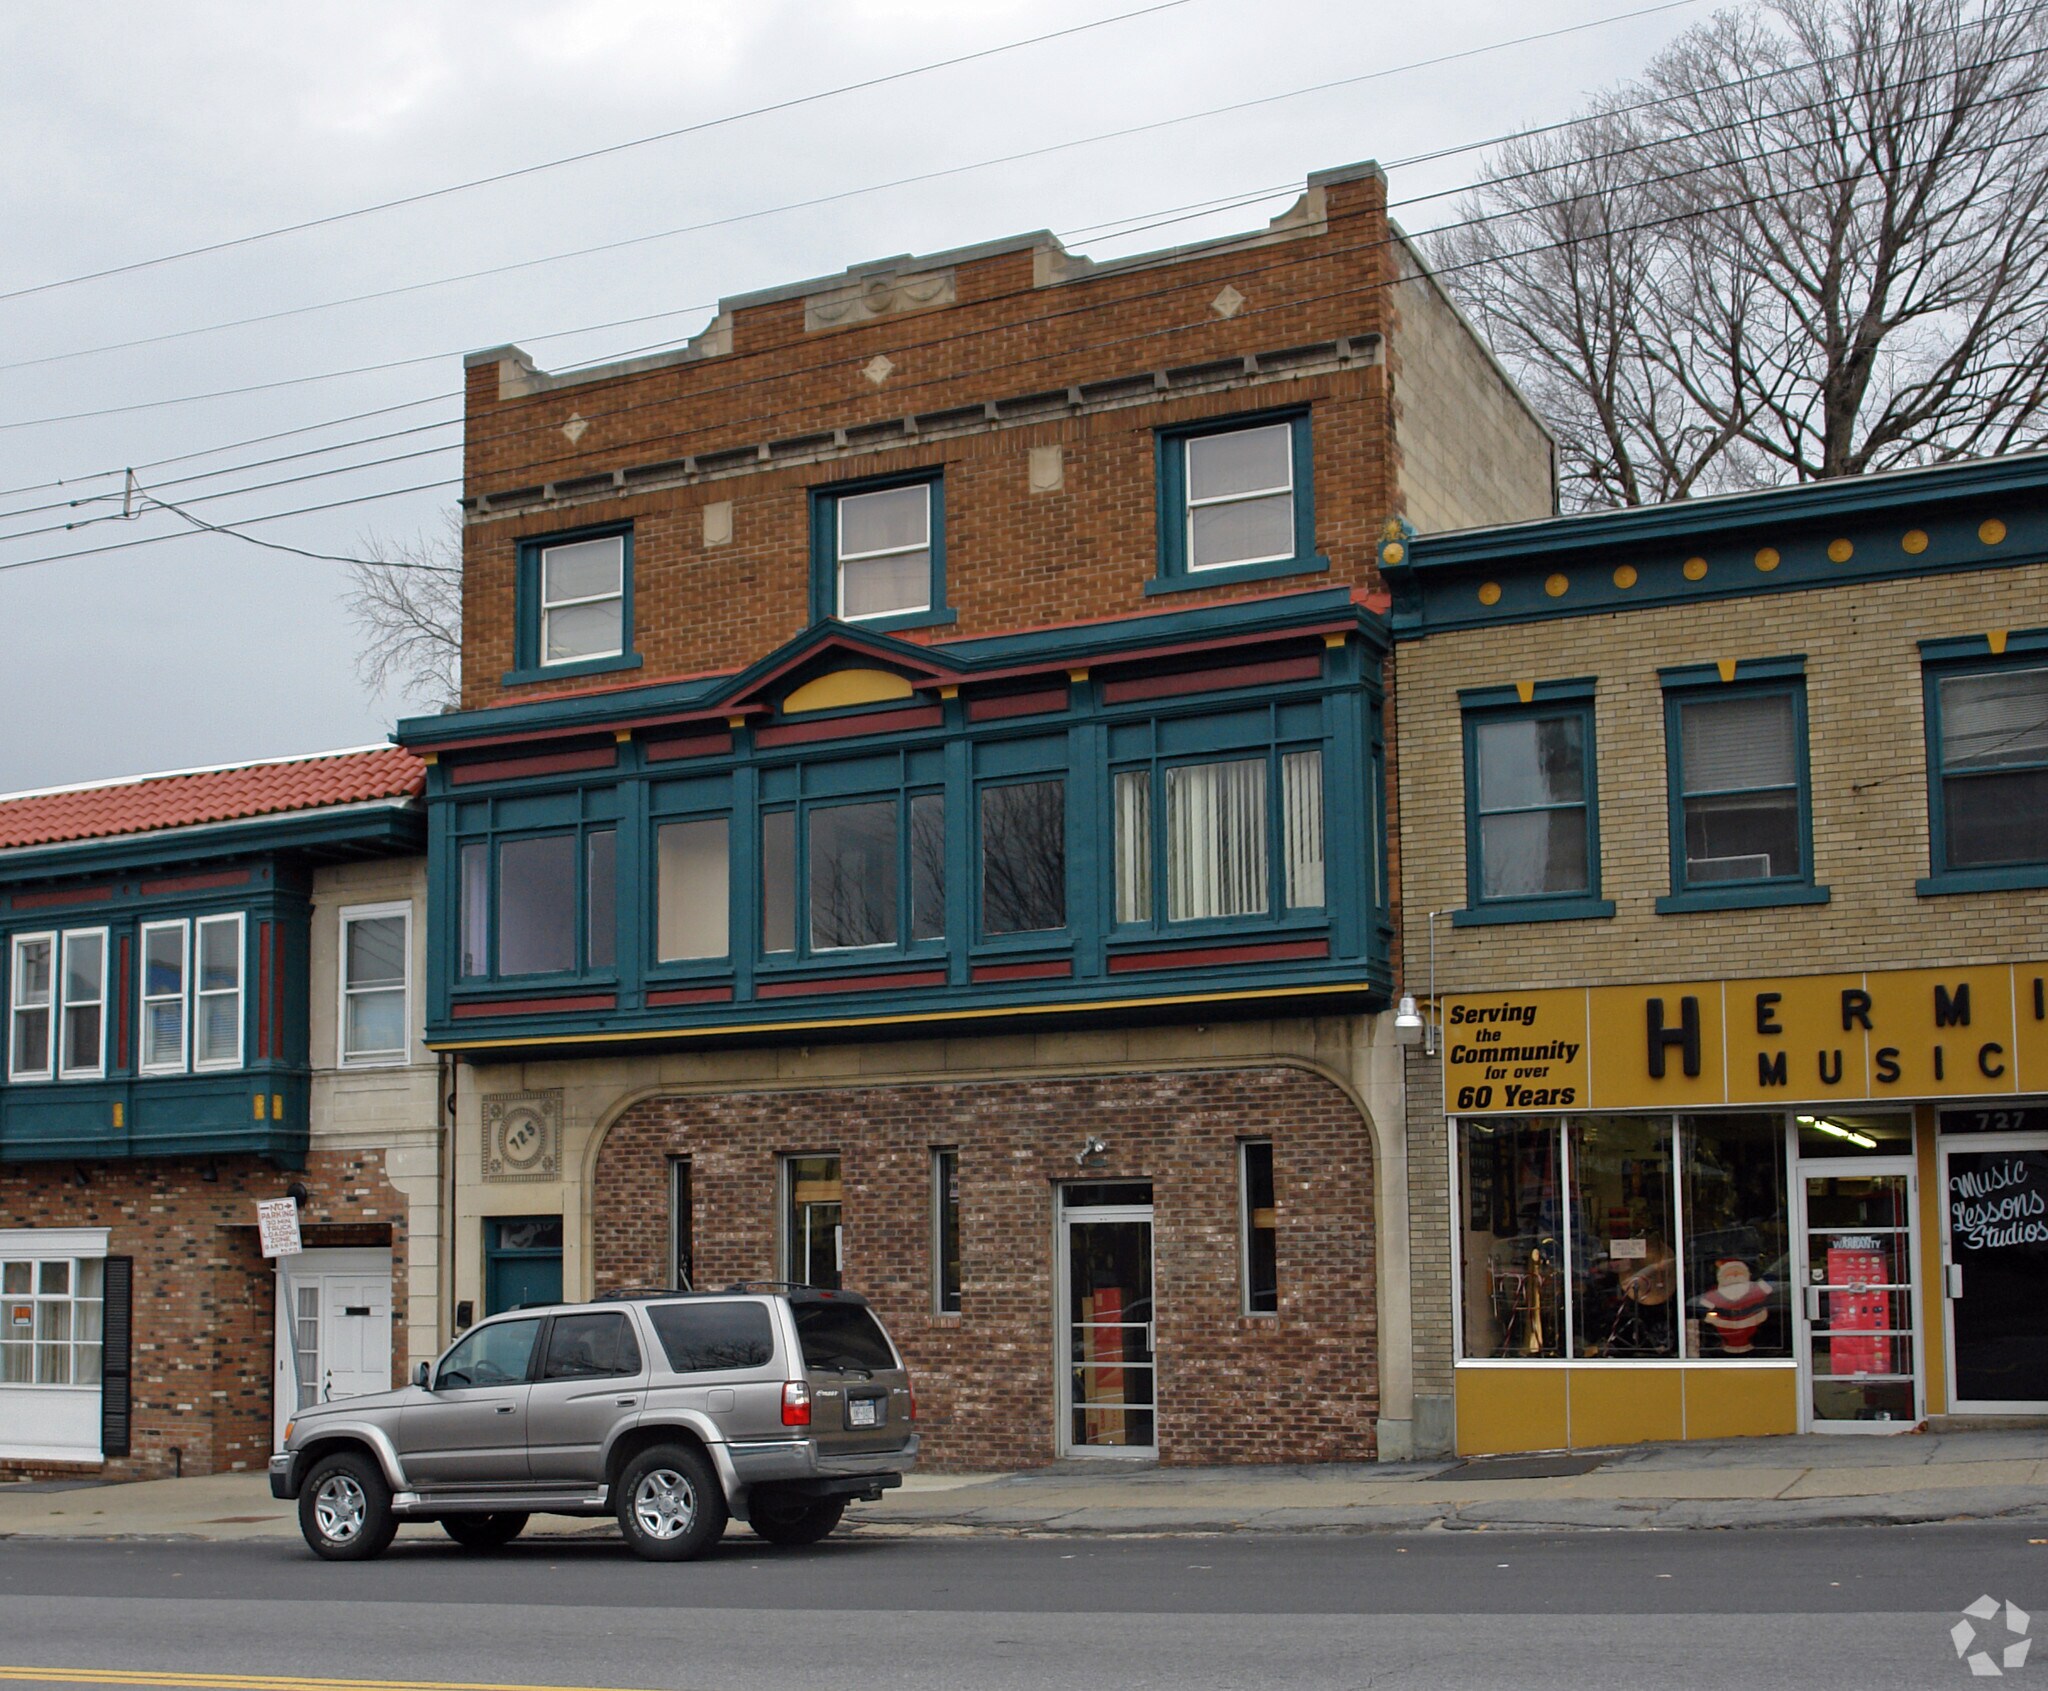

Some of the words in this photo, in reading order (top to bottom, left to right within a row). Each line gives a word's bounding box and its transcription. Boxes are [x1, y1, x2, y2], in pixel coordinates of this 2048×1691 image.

[1450, 1002, 1537, 1026] Serving
[1475, 1028, 1502, 1042] the
[1450, 1040, 1580, 1064] Community
[1485, 1065, 1508, 1080] for
[1513, 1067, 1550, 1079] over
[1757, 1042, 2005, 1087] MUSIC
[1457, 1085, 1493, 1109] 60
[1504, 1084, 1576, 1107] Years
[1975, 1111, 2025, 1131] 727
[508, 1120, 536, 1151] 725
[1949, 1159, 2029, 1198] Music
[261, 1209, 295, 1220] PARKING
[270, 1203, 284, 1211] NO
[1951, 1189, 2046, 1233] Lessons
[263, 1229, 297, 1239] LOADING
[267, 1223, 293, 1232] TRUCK
[1962, 1220, 2048, 1250] Studios
[270, 1236, 291, 1244] ZONE
